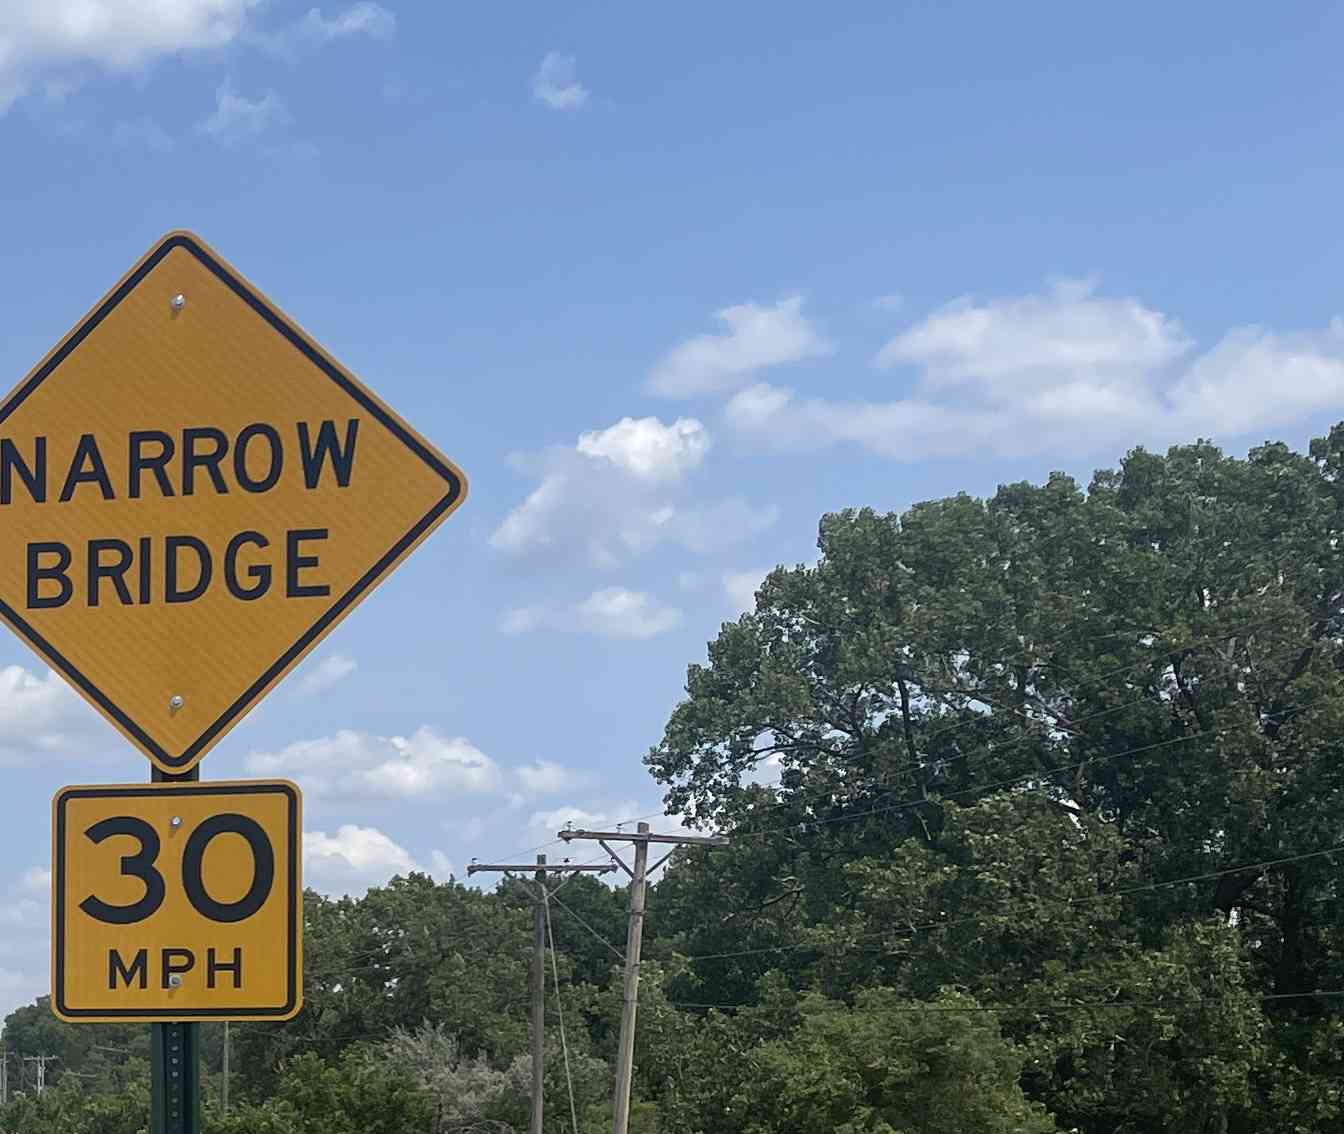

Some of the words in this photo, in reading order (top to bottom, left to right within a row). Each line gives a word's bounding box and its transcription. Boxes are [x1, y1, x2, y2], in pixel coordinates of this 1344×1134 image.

[0, 418, 360, 506] NARROW
[26, 528, 331, 610] BRIDGE
[78, 812, 275, 925] 30
[108, 947, 242, 990] MPH
